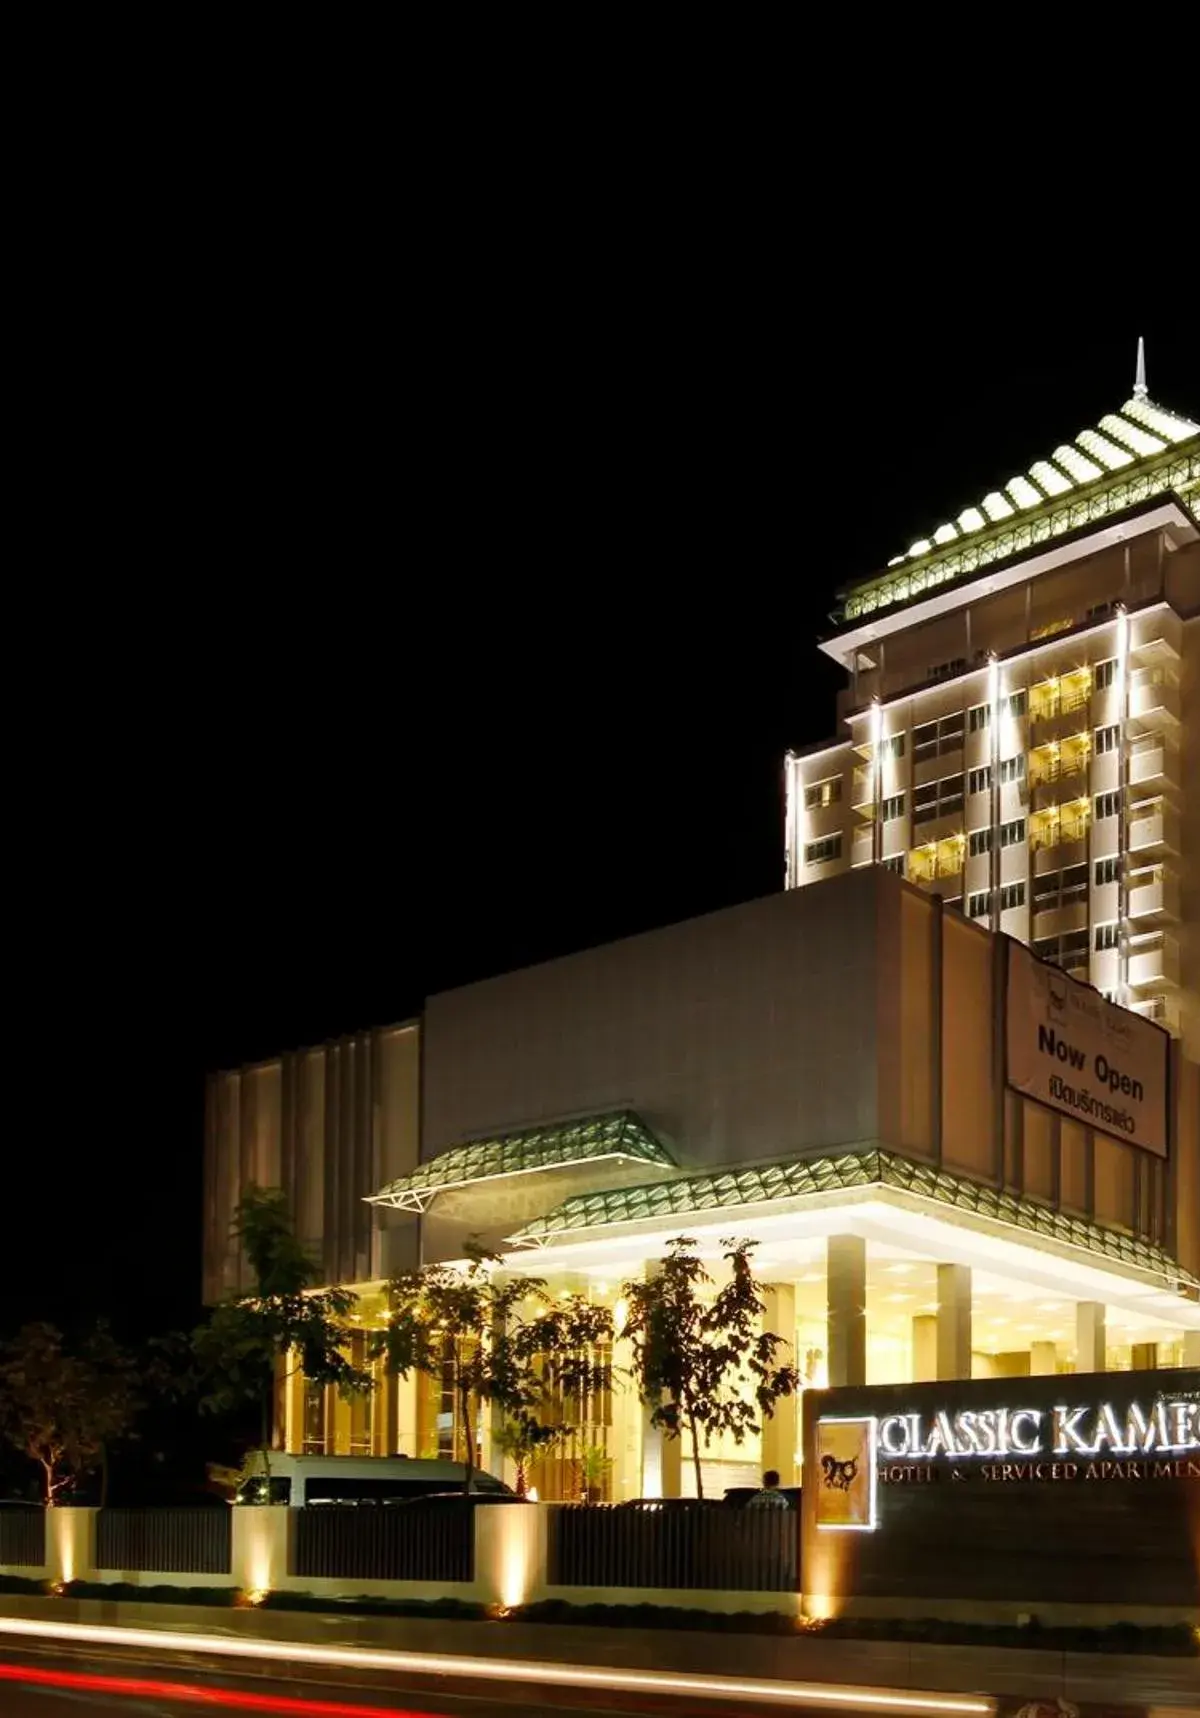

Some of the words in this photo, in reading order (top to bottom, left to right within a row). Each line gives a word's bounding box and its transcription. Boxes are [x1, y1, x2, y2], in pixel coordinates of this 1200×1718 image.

[1038, 1024, 1085, 1071] Now
[1094, 1053, 1143, 1101] Open
[1048, 1074, 1135, 1134] เปิดบริการแล้ว
[880, 1408, 1042, 1457] CLASSIC
[877, 1463, 934, 1482] HOTEL
[951, 1466, 968, 1482] &
[980, 1462, 1078, 1482] SERVICED
